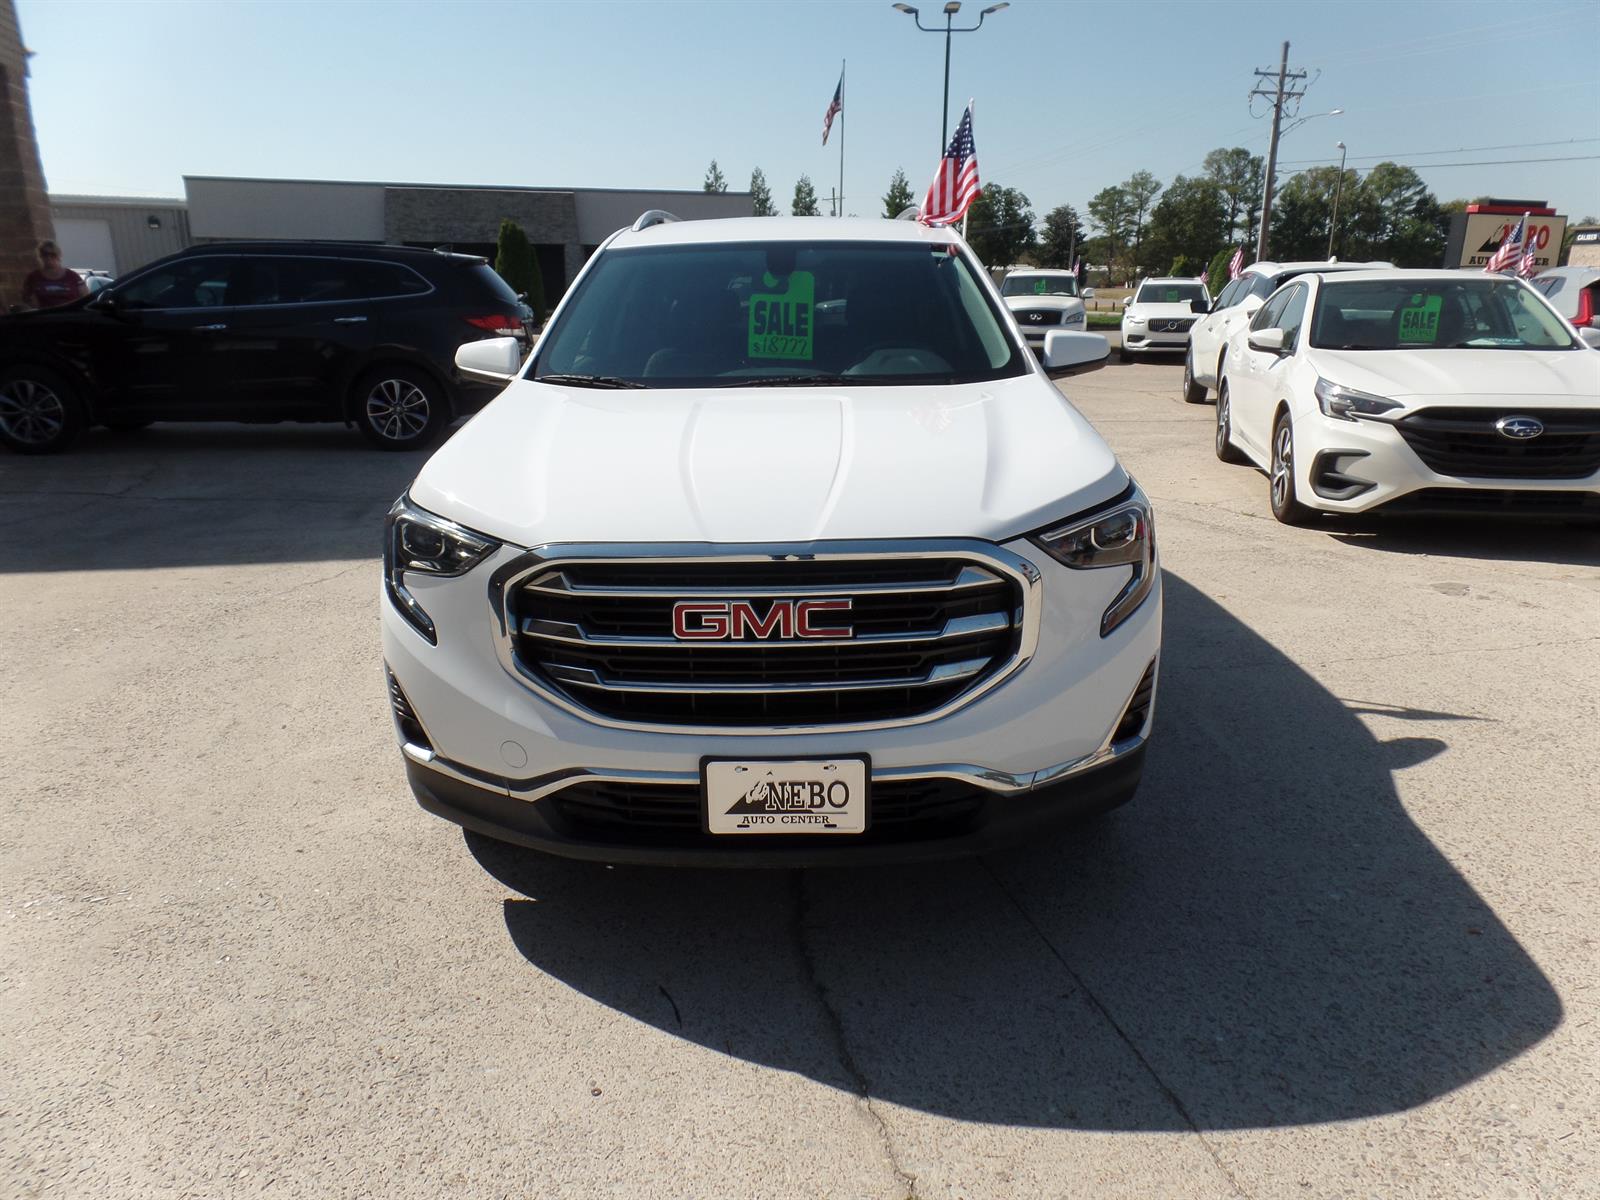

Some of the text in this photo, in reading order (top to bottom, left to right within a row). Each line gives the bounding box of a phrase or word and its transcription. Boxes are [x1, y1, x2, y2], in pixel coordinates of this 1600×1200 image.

[1500, 223, 1550, 250] NBO
[753, 300, 809, 337] SALE
[1402, 311, 1438, 330] SALE
[673, 599, 852, 640] GMC
[765, 780, 850, 809] NEBO
[742, 815, 830, 824] AUTO CENTER
